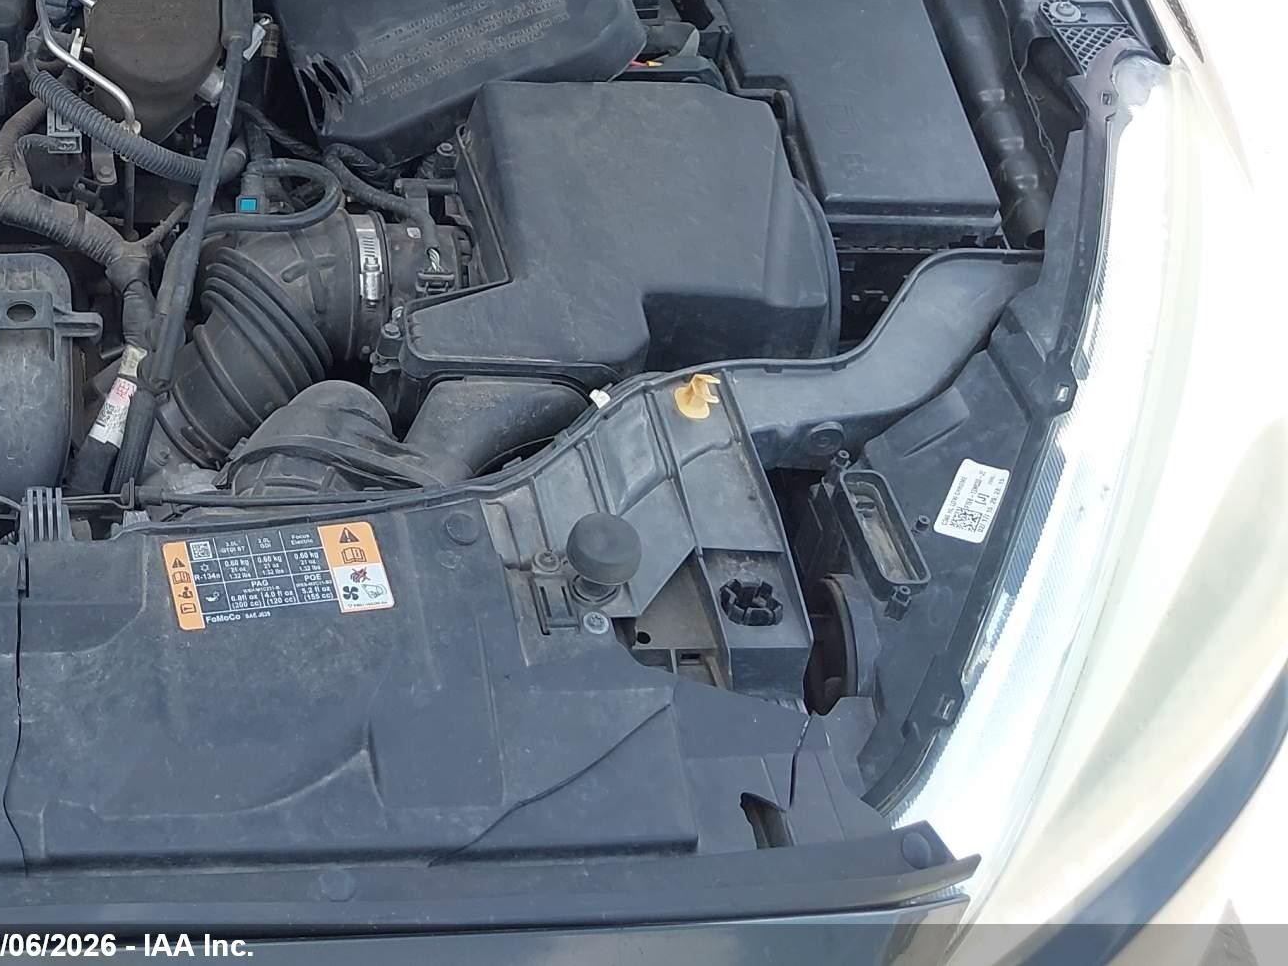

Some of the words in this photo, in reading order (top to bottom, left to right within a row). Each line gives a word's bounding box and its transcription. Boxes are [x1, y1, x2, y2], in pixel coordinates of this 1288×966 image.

[274, 555, 282, 563] kg
[194, 572, 220, 580] R-134a
[266, 597, 283, 605] (120
[285, 595, 296, 603] cc)
[304, 593, 320, 602] (155
[322, 592, 334, 600] cc)
[232, 601, 248, 609] (200
[206, 614, 241, 623] FoMoCo
